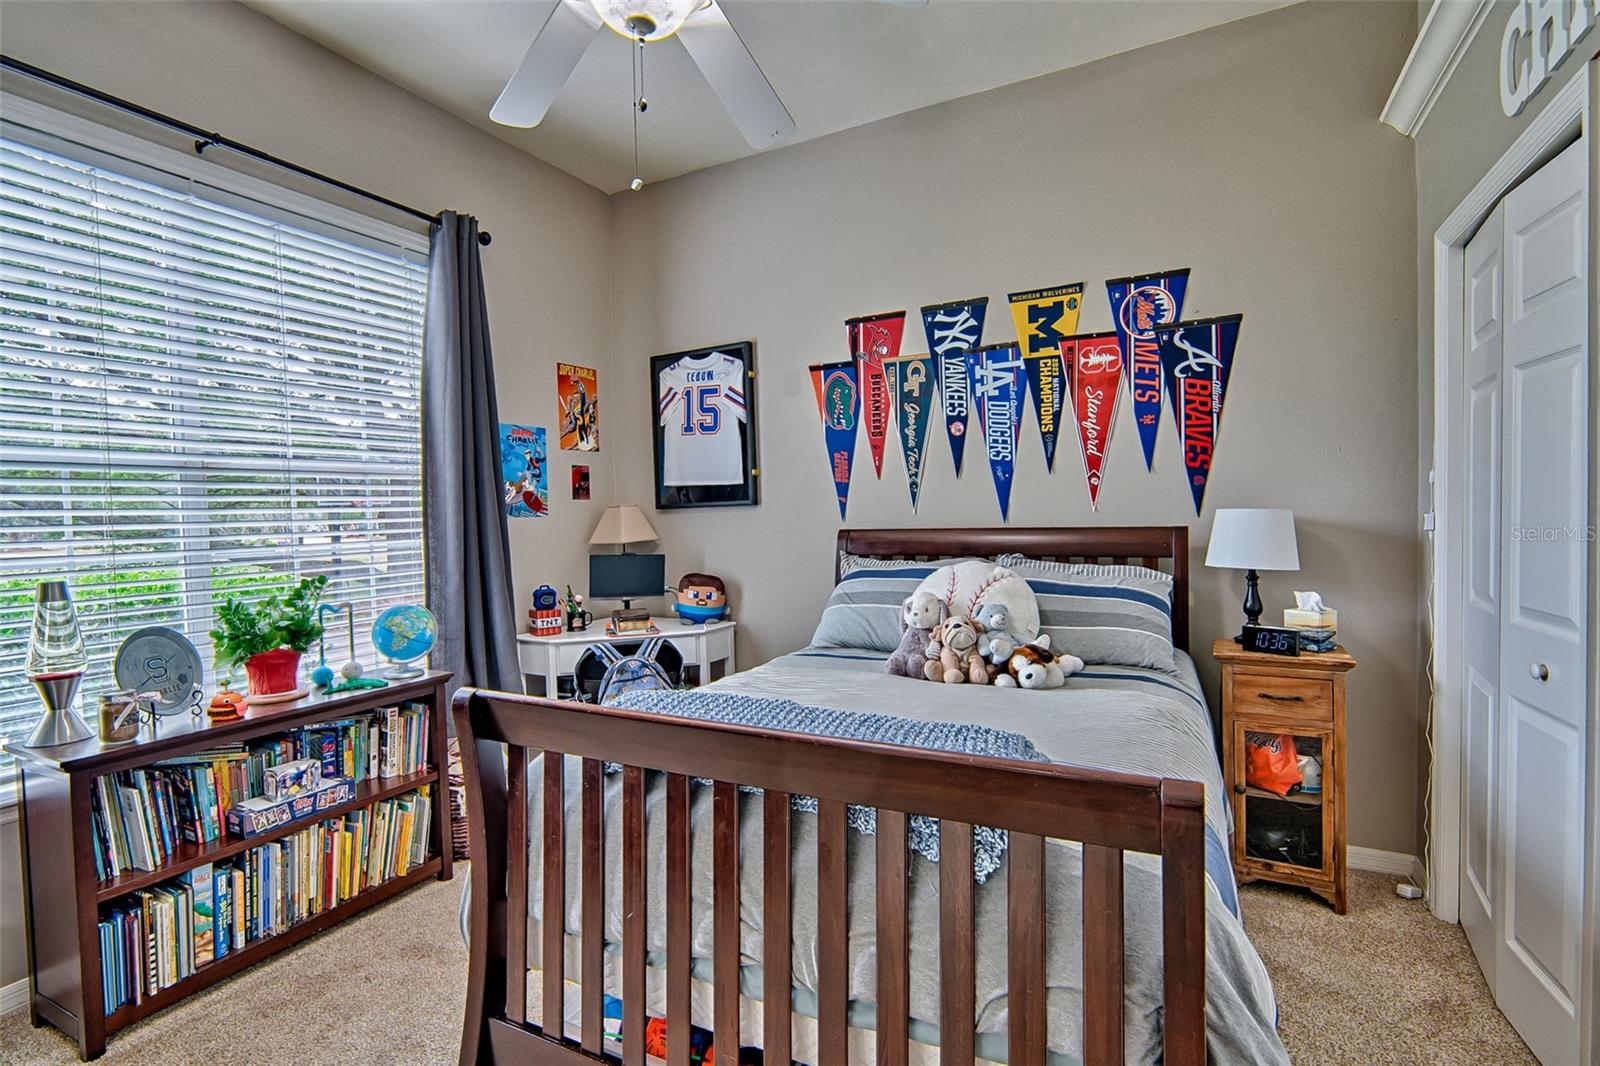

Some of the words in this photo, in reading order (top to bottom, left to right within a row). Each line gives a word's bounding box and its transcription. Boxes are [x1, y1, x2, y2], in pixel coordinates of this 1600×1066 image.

[1011, 293, 1040, 301] MICHIGAN
[1042, 286, 1080, 297] WOLVERINES
[1027, 300, 1065, 354] M
[686, 370, 714, 383] TEBOW
[945, 356, 967, 417] YANKEES
[974, 356, 1026, 397] LA
[1051, 359, 1059, 376] 2023
[1134, 341, 1160, 403] METS
[681, 384, 722, 436] 15
[870, 373, 883, 438] BUCCANEERS
[1040, 359, 1054, 432] CHAMPIONS
[1052, 377, 1060, 412] NATIONAL
[903, 402, 920, 447] Georgia
[988, 401, 1012, 462] DODGERS
[1081, 385, 1104, 457] Stanford
[1184, 377, 1213, 470] BRAVES
[907, 447, 919, 475] Tech
[540, 618, 558, 627] TNT
[1255, 631, 1289, 650] 10:36
